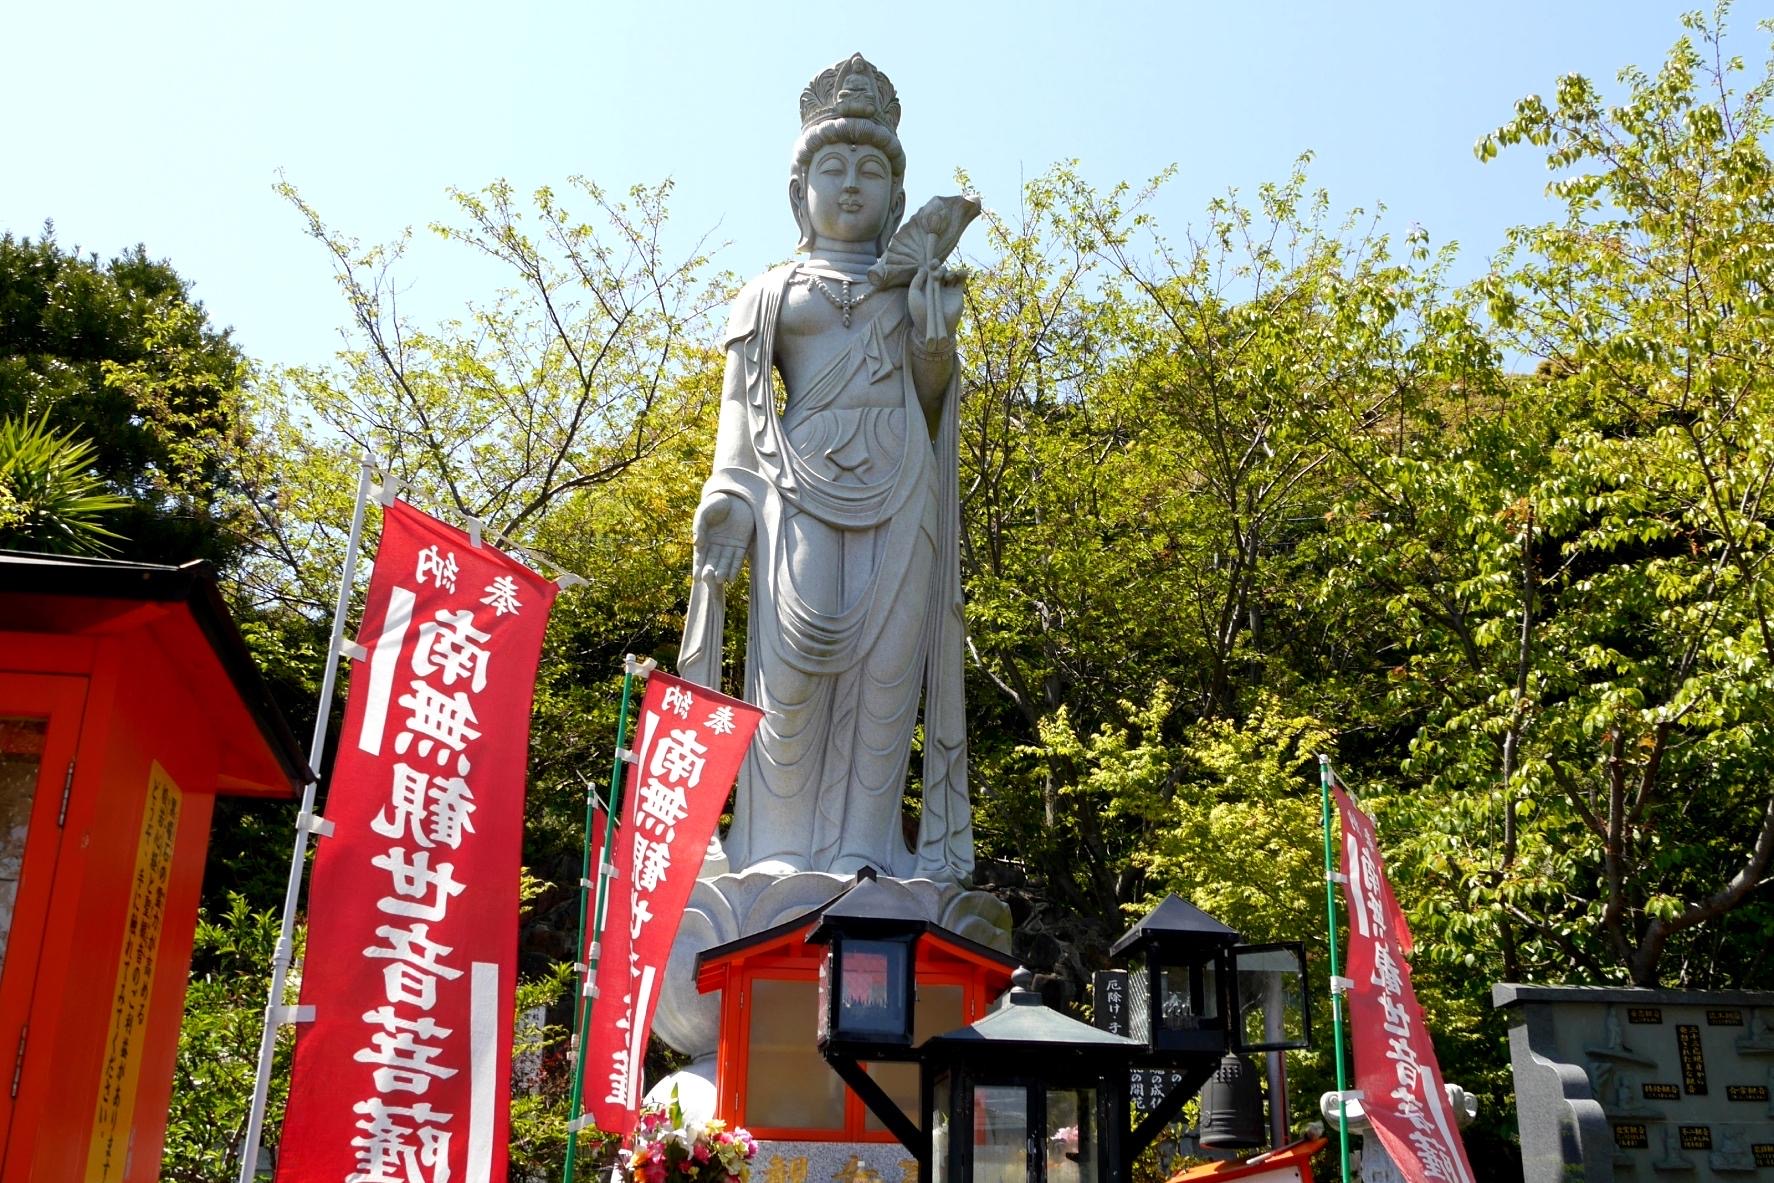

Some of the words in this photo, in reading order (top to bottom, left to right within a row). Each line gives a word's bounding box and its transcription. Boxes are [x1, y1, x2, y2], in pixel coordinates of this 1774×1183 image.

[1106, 979, 1122, 1035] 厄除け・子
